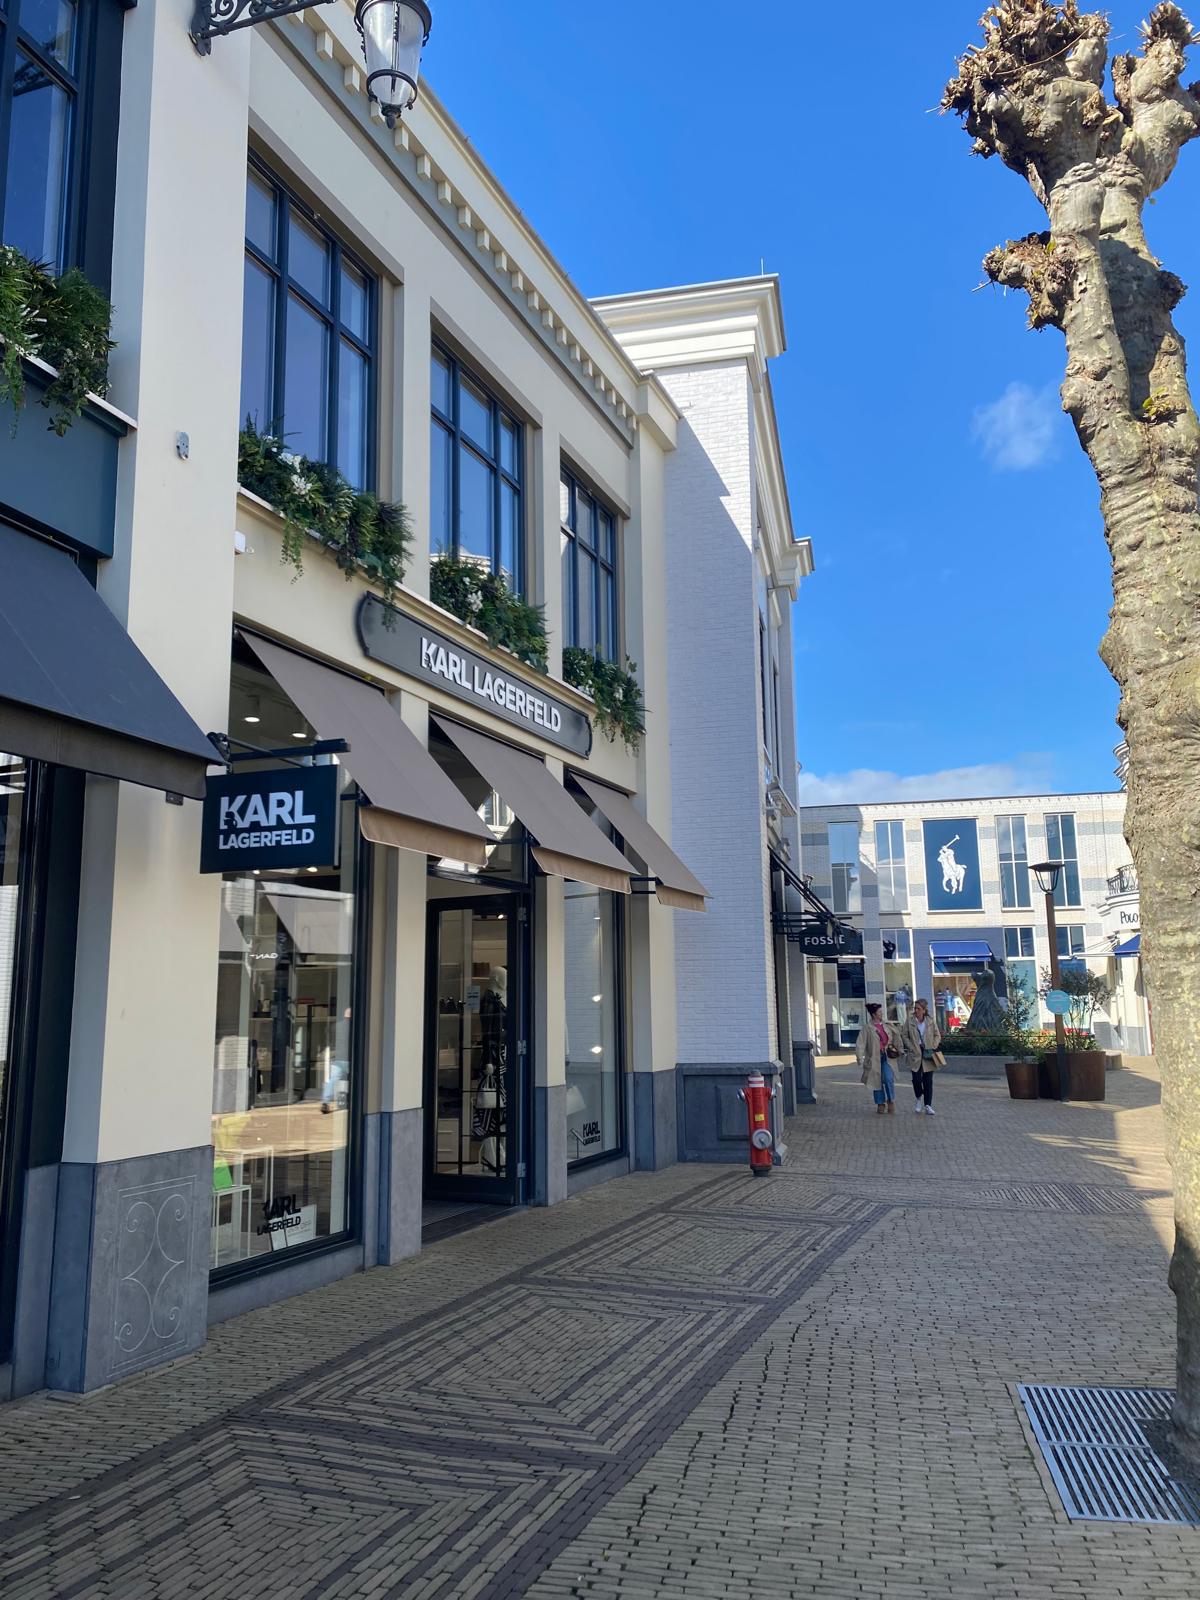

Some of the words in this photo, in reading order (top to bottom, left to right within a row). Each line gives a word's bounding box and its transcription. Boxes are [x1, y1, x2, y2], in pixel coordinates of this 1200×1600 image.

[420, 636, 472, 690] KARL
[473, 665, 562, 733] LAGERFELD
[219, 790, 316, 829] KARL
[218, 828, 315, 850] LAGERFELD
[804, 934, 846, 946] FOSSIL
[583, 1121, 601, 1138] KARL
[256, 1216, 302, 1237] LAGERFELD
